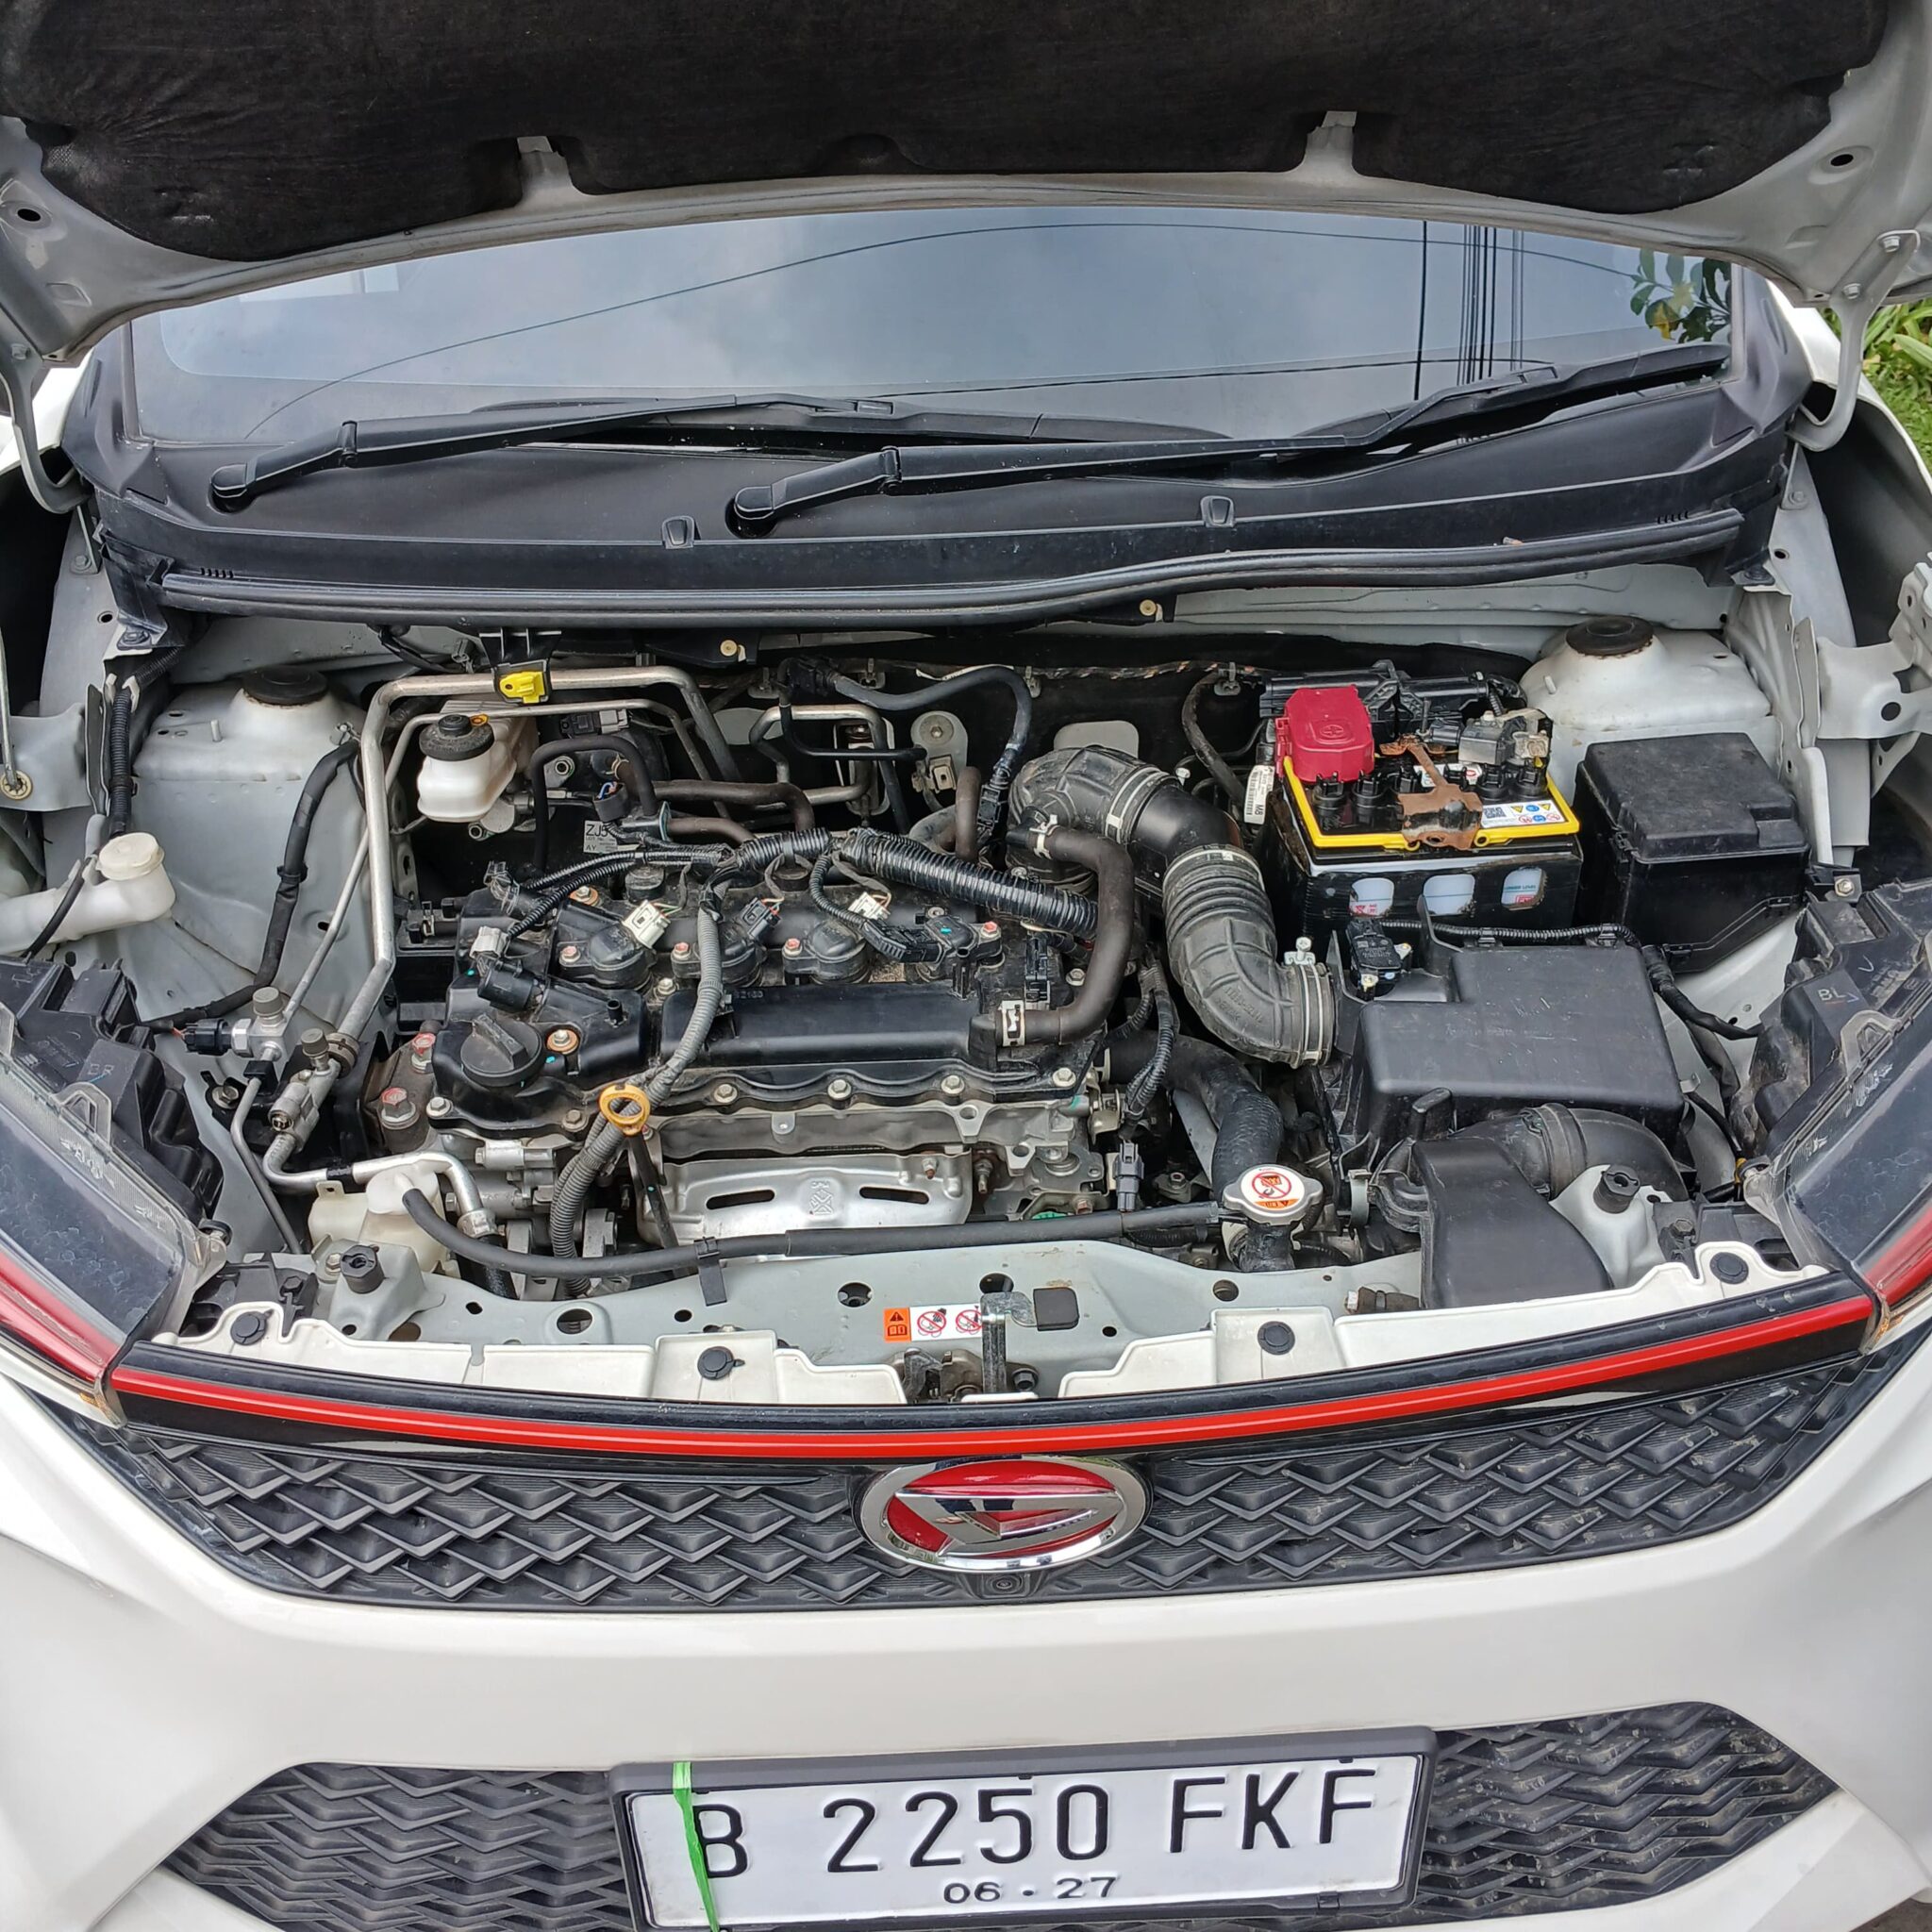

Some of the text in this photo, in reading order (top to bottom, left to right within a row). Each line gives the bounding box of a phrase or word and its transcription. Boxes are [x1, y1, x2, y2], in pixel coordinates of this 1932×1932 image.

[691, 1769, 1375, 1879] B 2250 FKF
[943, 1882, 1001, 1905] 06
[1056, 1876, 1116, 1899] 27
